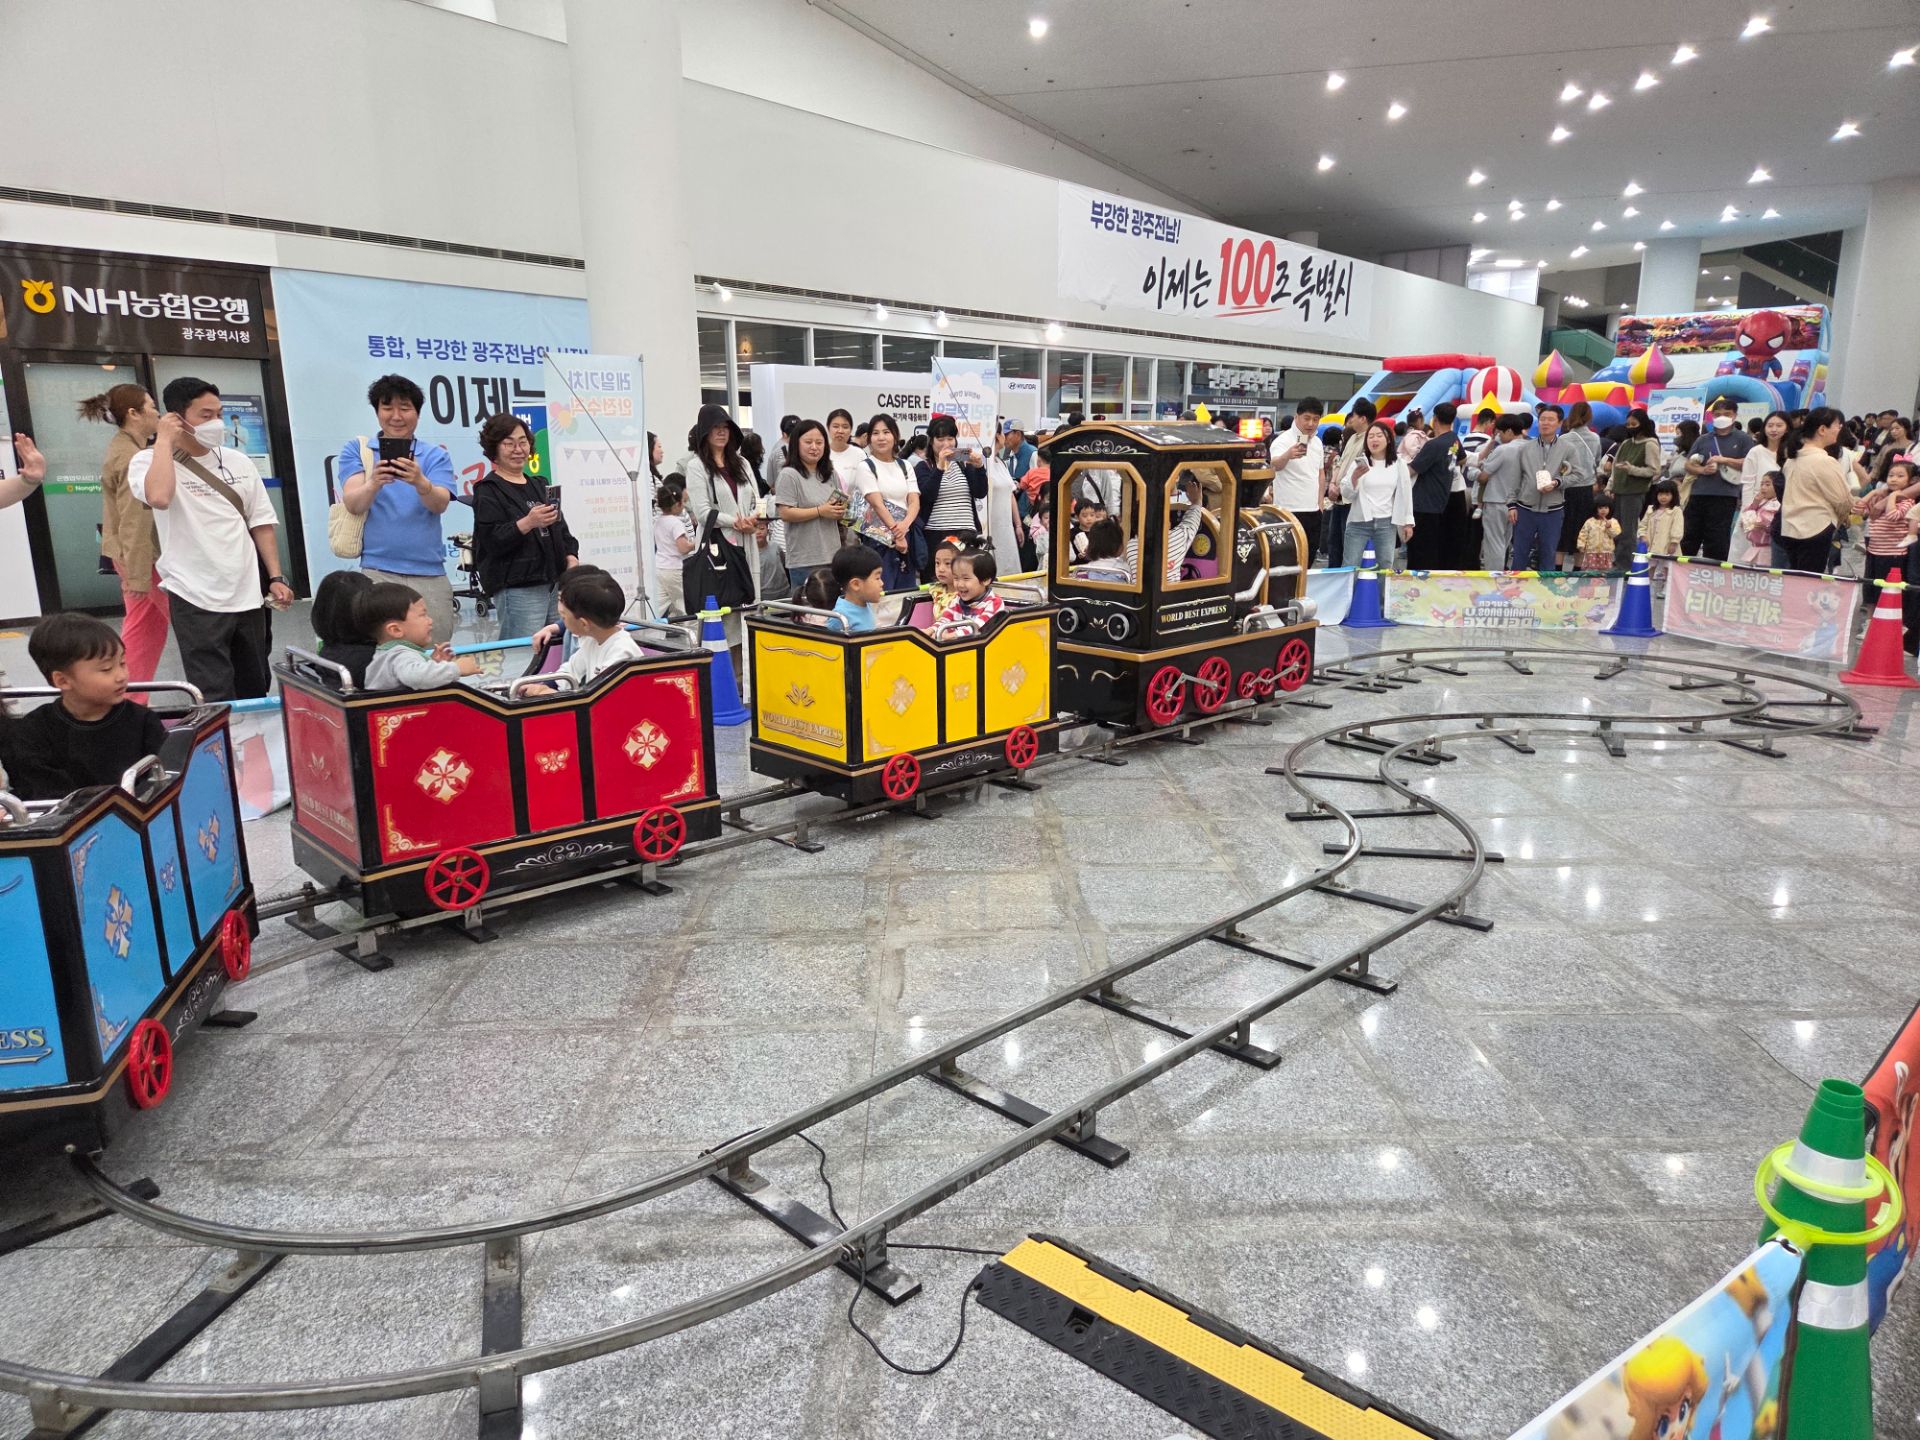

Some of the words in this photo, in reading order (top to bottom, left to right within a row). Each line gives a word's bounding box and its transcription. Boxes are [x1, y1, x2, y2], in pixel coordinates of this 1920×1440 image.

[1090, 200, 1129, 233] 부강한
[1131, 208, 1182, 244] 광주전남!
[1142, 256, 1213, 310] 이제는
[1217, 237, 1292, 306] 100조
[1293, 256, 1354, 322] 특별시
[62, 285, 250, 325] NH농협은행
[181, 327, 250, 344] 광주광역시청
[368, 335, 411, 360] 통합,
[416, 338, 467, 361] 부강한
[877, 393, 921, 408] CASPER
[1161, 612, 1183, 623] WORLD
[1184, 608, 1200, 619] BEST
[1201, 605, 1227, 616] EXPRESS
